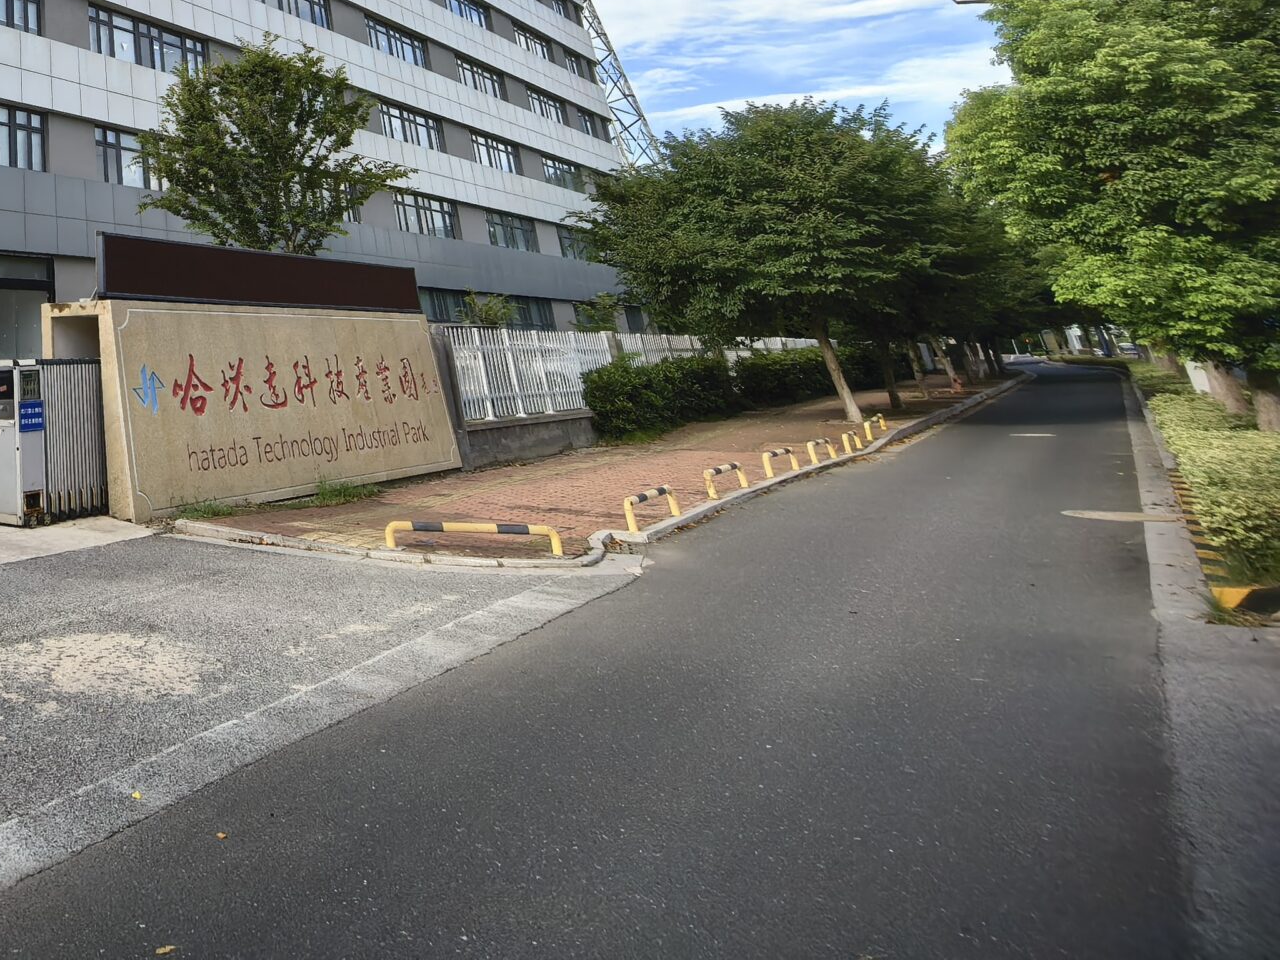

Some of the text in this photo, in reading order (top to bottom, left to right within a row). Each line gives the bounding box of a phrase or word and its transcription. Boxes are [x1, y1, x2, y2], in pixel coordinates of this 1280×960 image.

[252, 431, 339, 463] Technology
[342, 420, 401, 452] Industrial
[402, 419, 429, 445] Park
